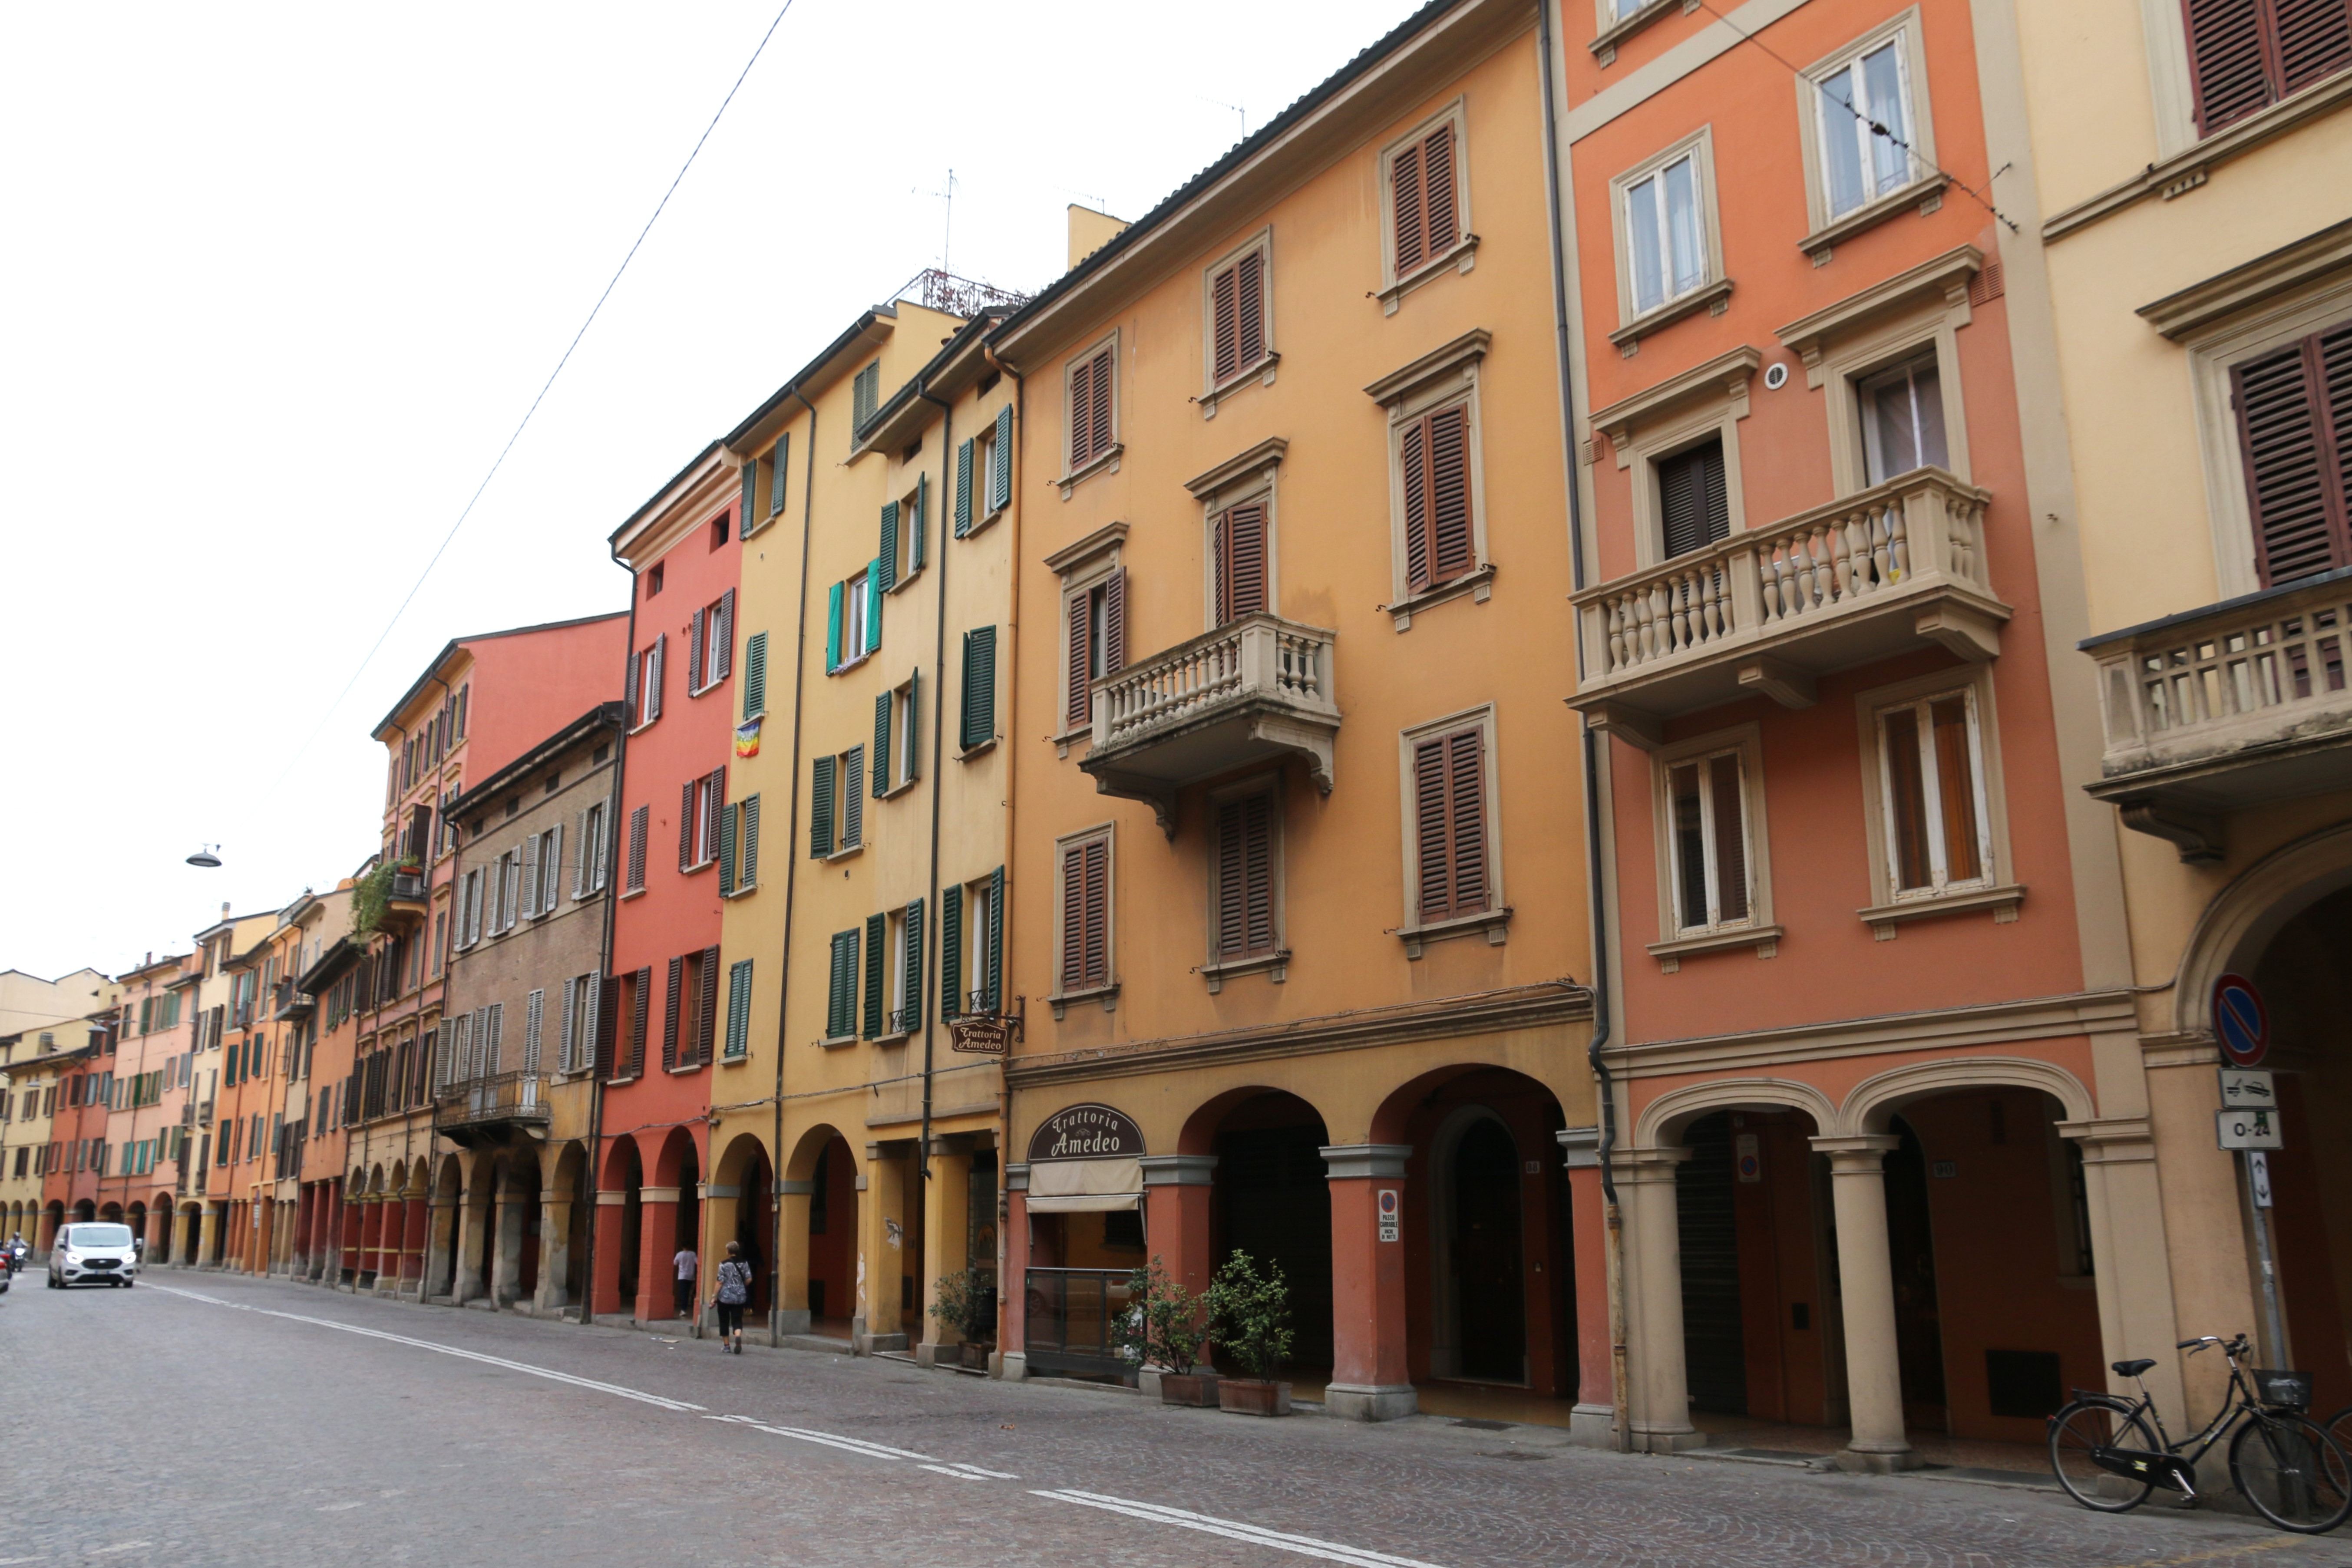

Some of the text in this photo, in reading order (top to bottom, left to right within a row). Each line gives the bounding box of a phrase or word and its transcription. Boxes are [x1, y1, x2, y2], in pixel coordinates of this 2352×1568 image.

[960, 1027, 1001, 1039] Trattoria
[958, 1038, 1001, 1050] Amedeo
[1052, 1111, 1118, 1132] Trattoria
[1051, 1130, 1120, 1157] Amedeo
[1936, 1165, 1952, 1175] 90
